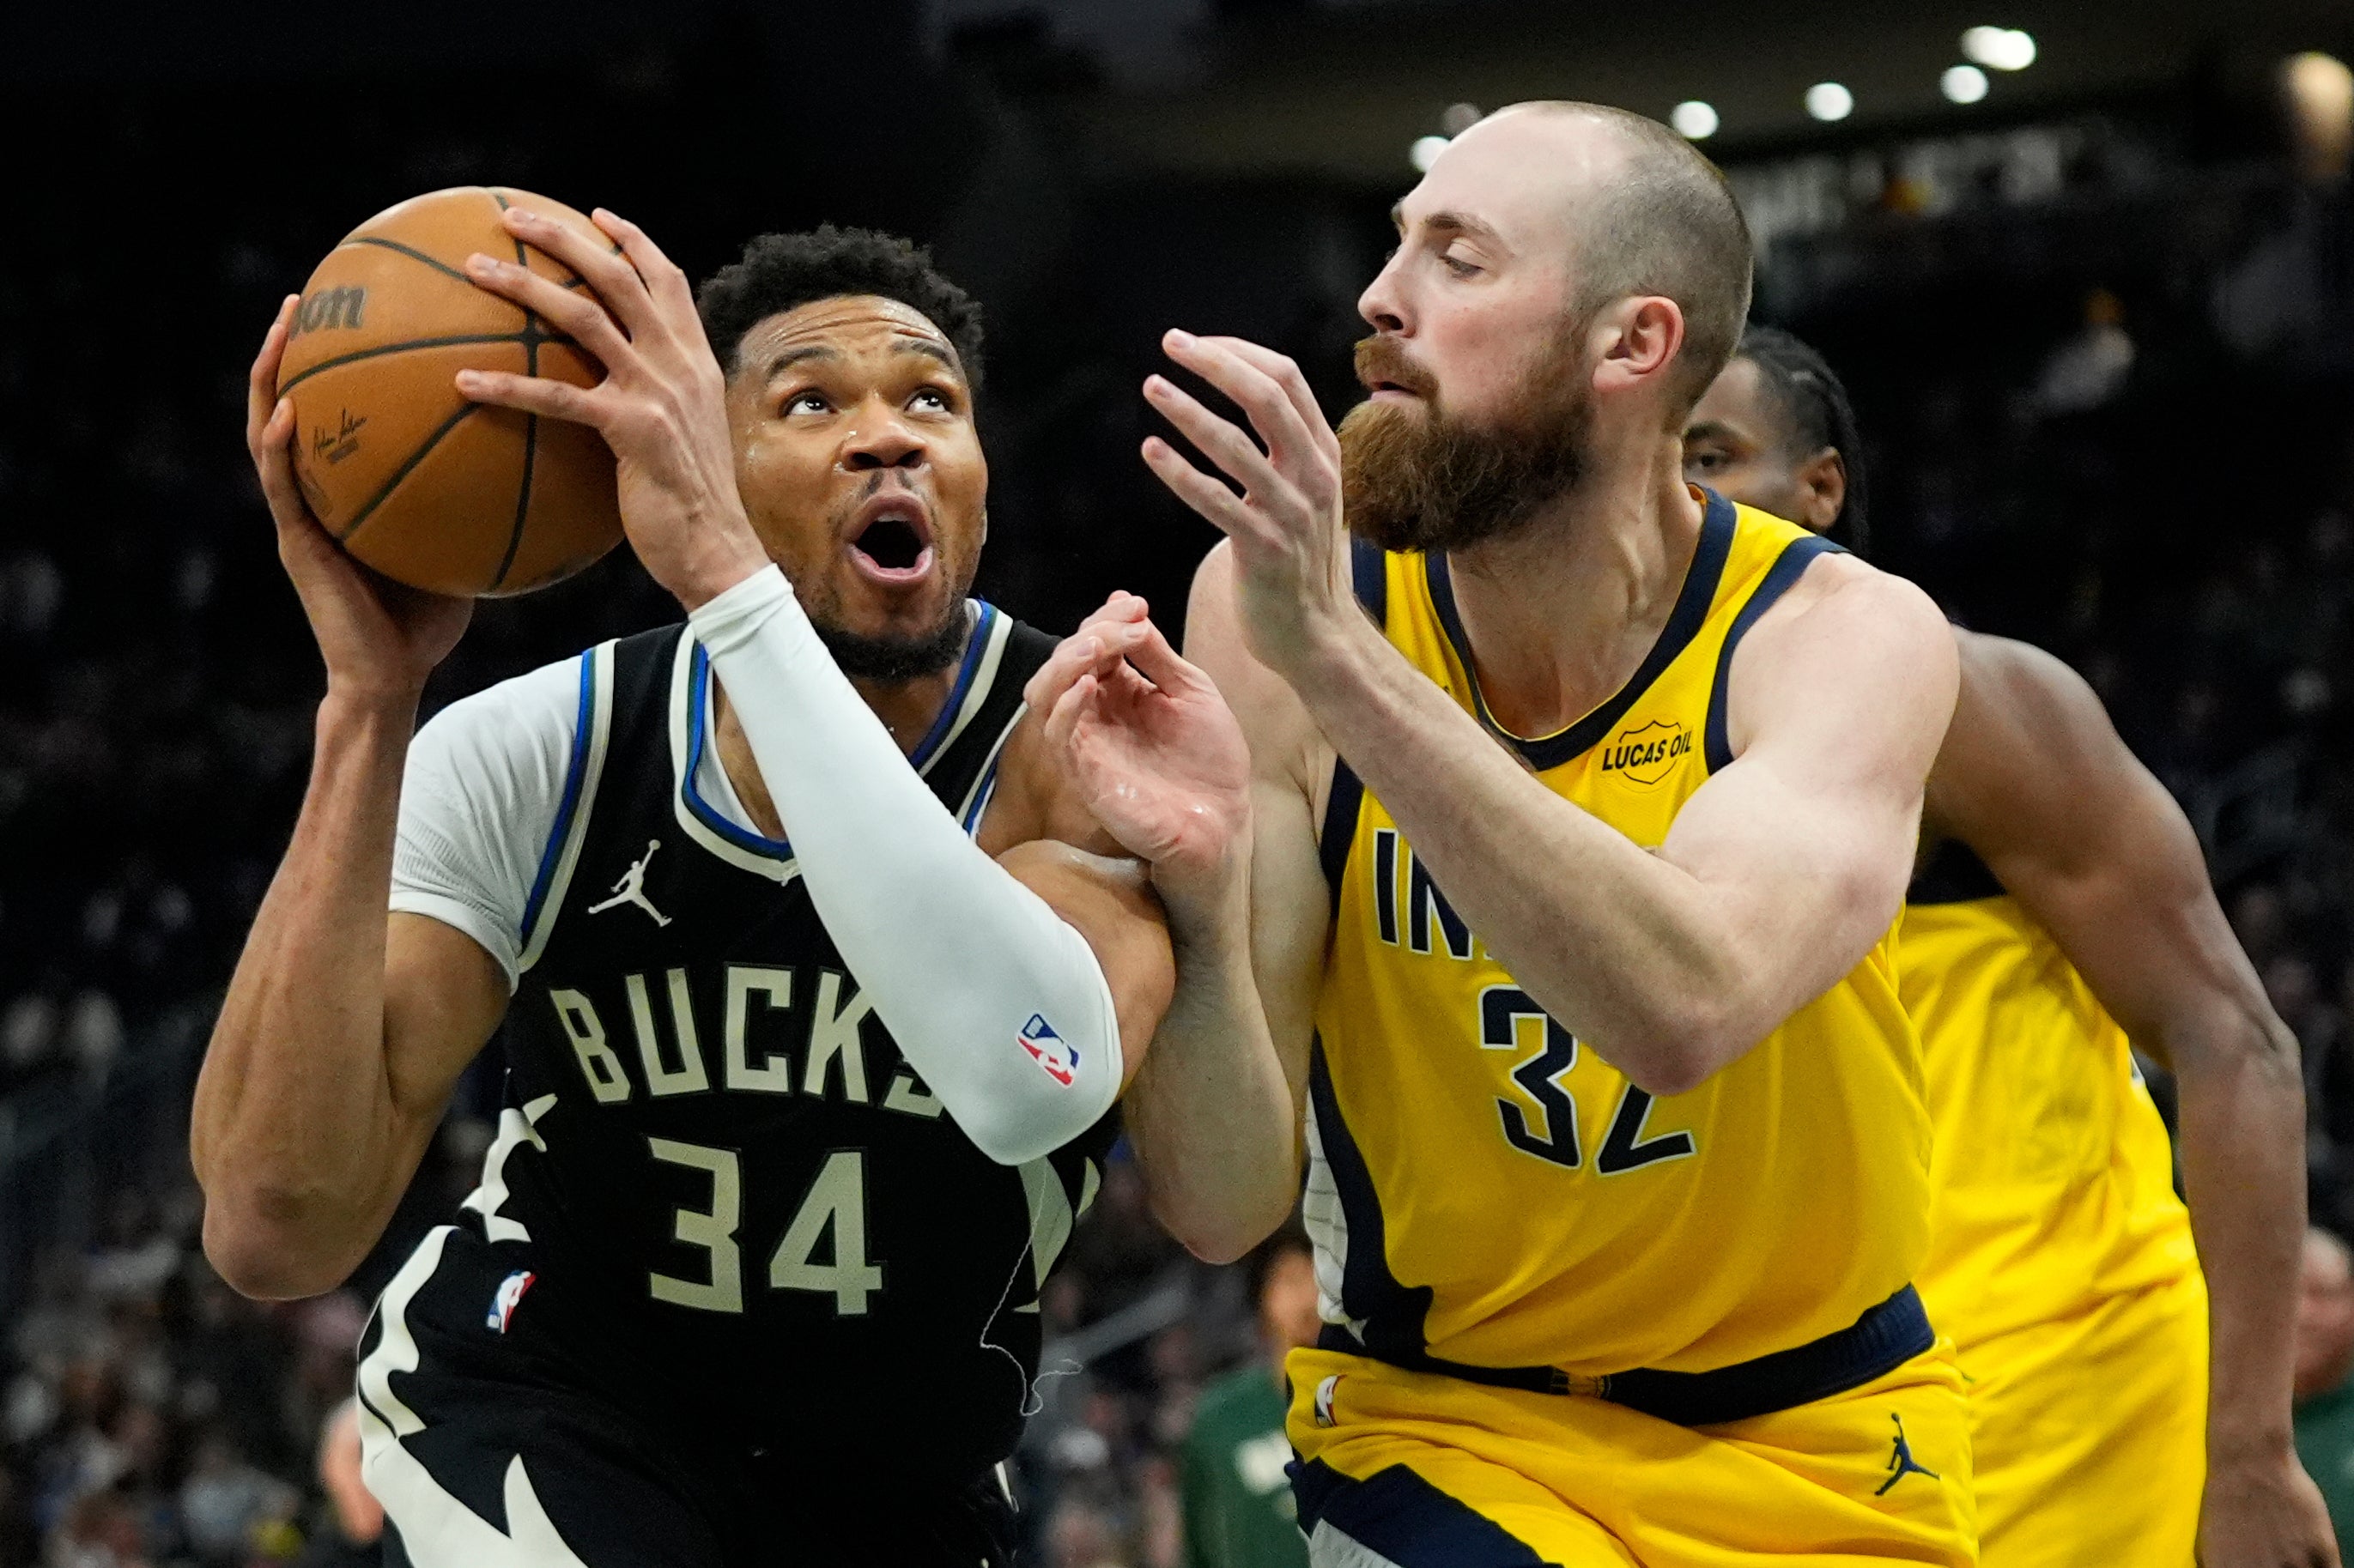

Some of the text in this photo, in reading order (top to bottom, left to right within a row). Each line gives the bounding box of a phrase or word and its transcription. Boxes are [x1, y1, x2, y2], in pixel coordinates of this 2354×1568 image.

[1602, 730, 1692, 771] LUCAS OIL
[647, 1135, 883, 1315] 34
